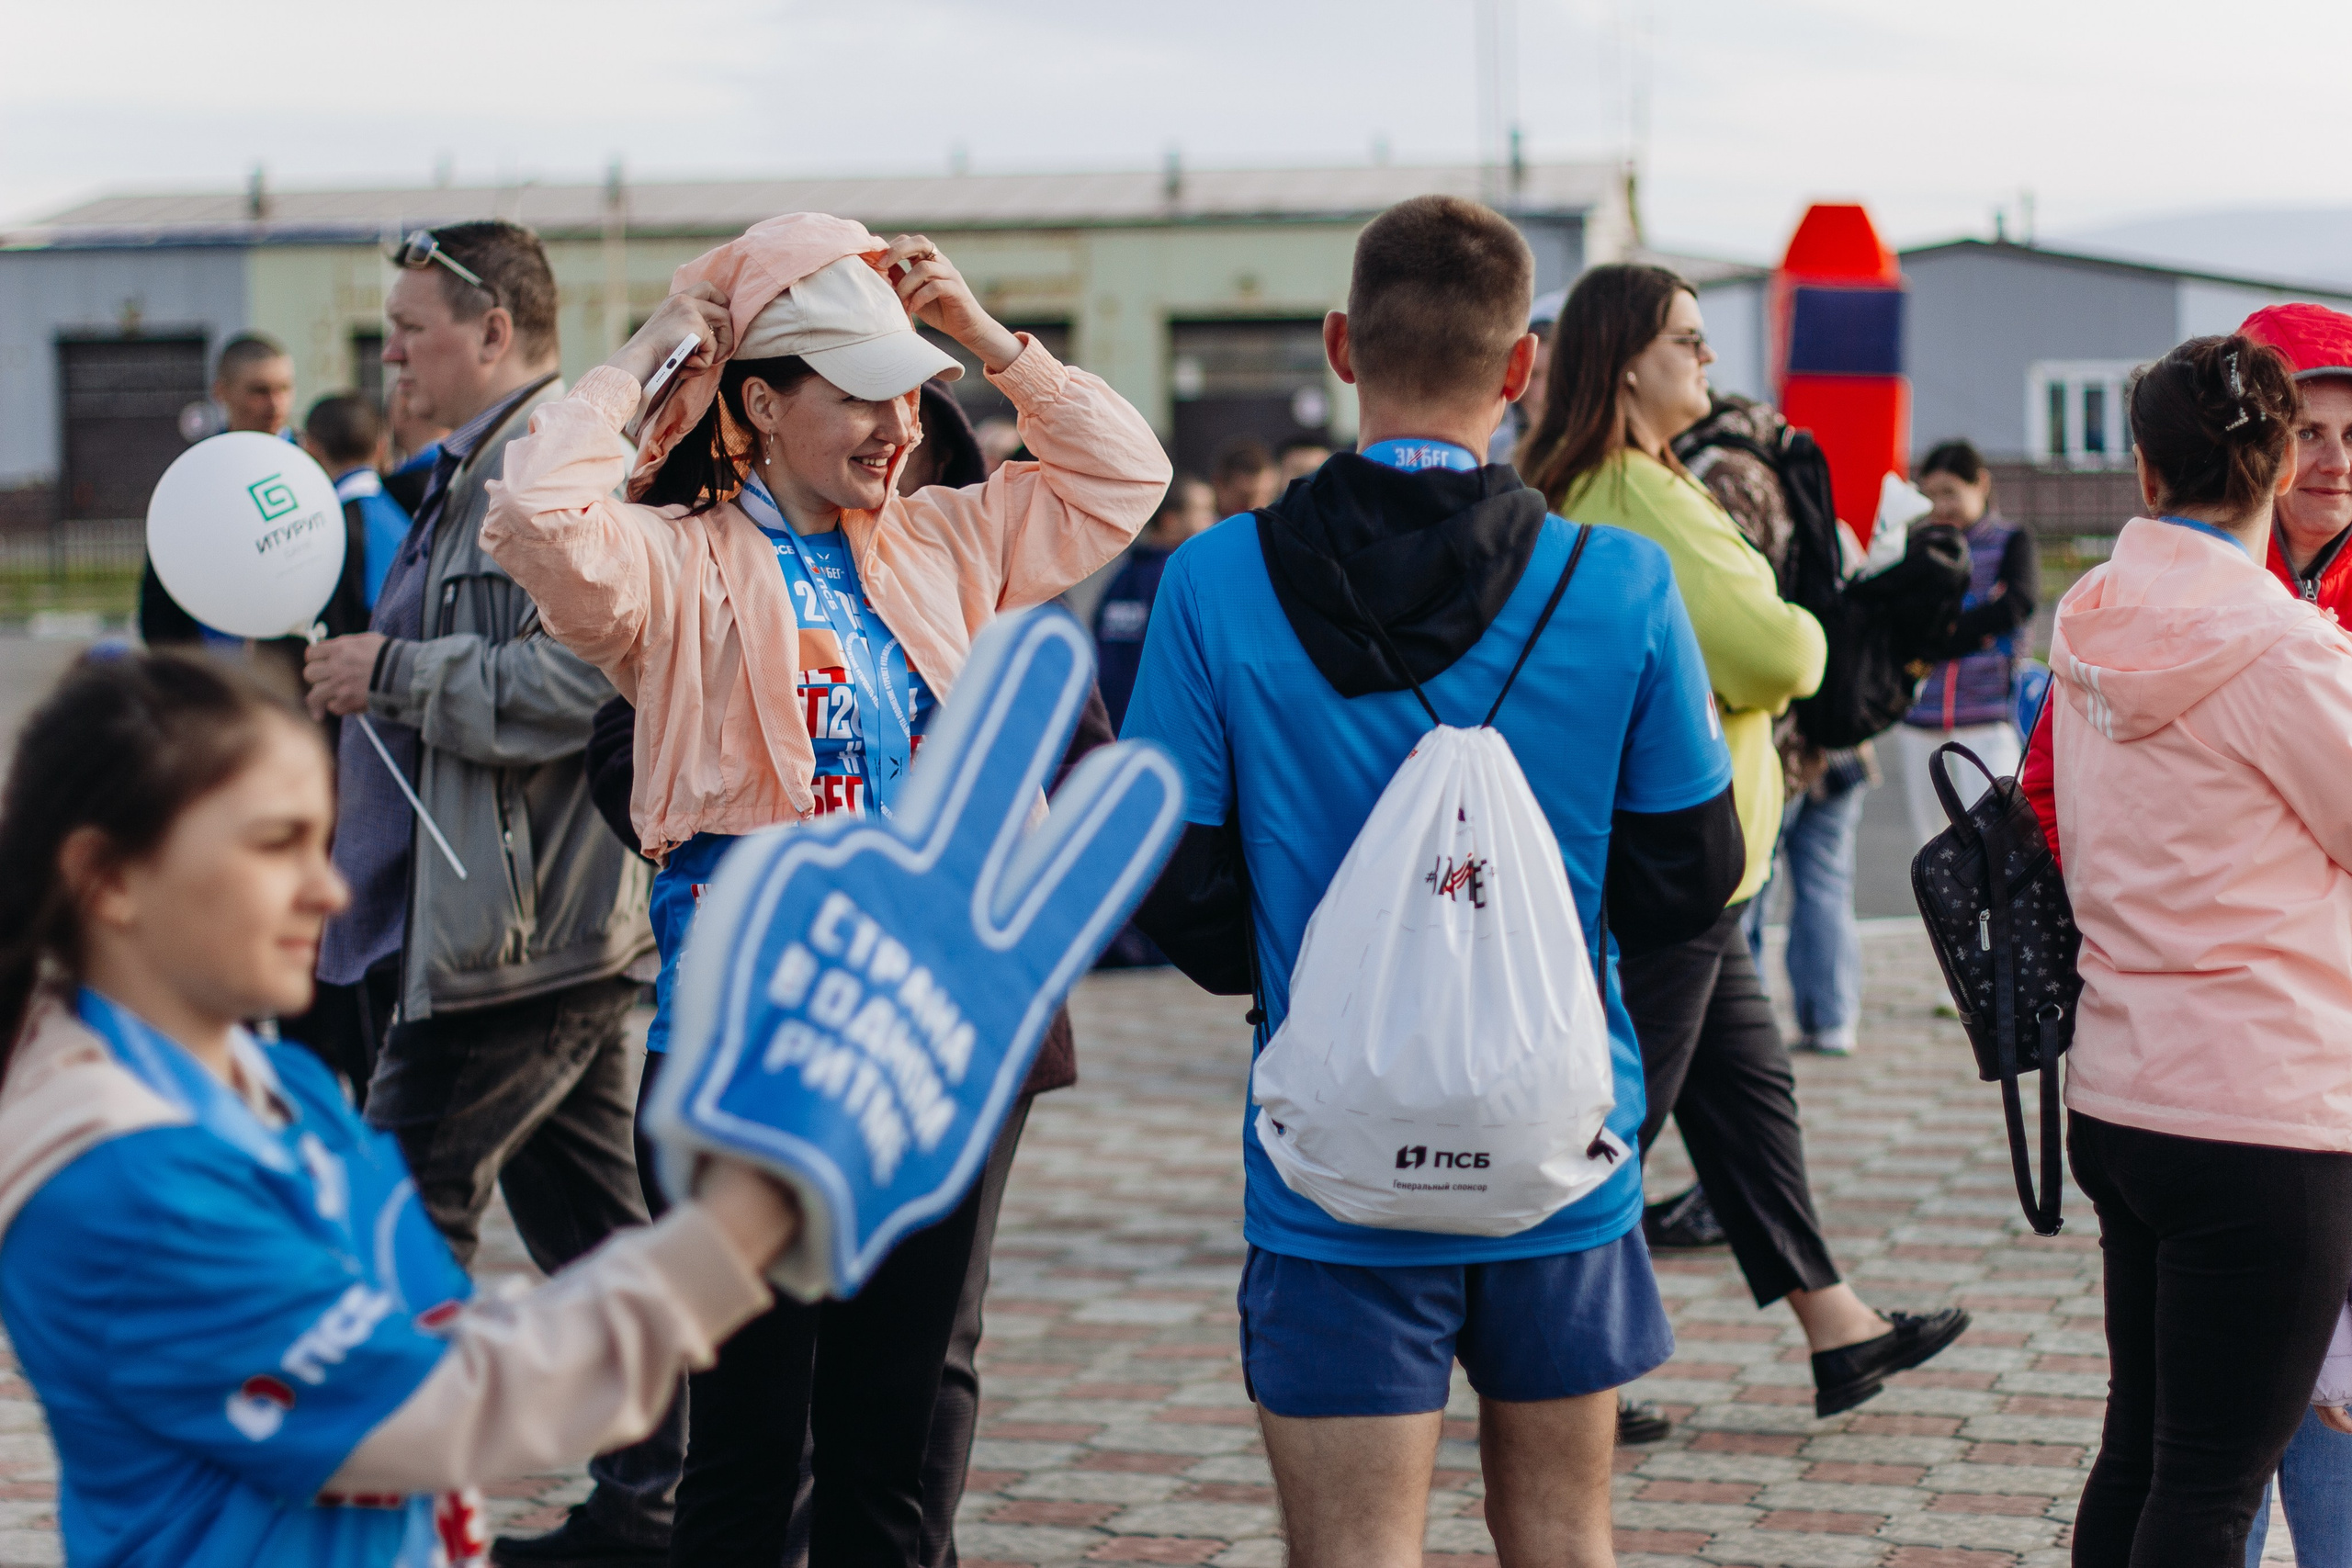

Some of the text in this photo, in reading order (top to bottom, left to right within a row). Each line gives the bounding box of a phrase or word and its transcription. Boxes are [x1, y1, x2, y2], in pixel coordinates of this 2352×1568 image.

[1433, 1151, 1490, 1169] ПСБ
[1393, 1179, 1487, 1193] Генеральный спонсор
